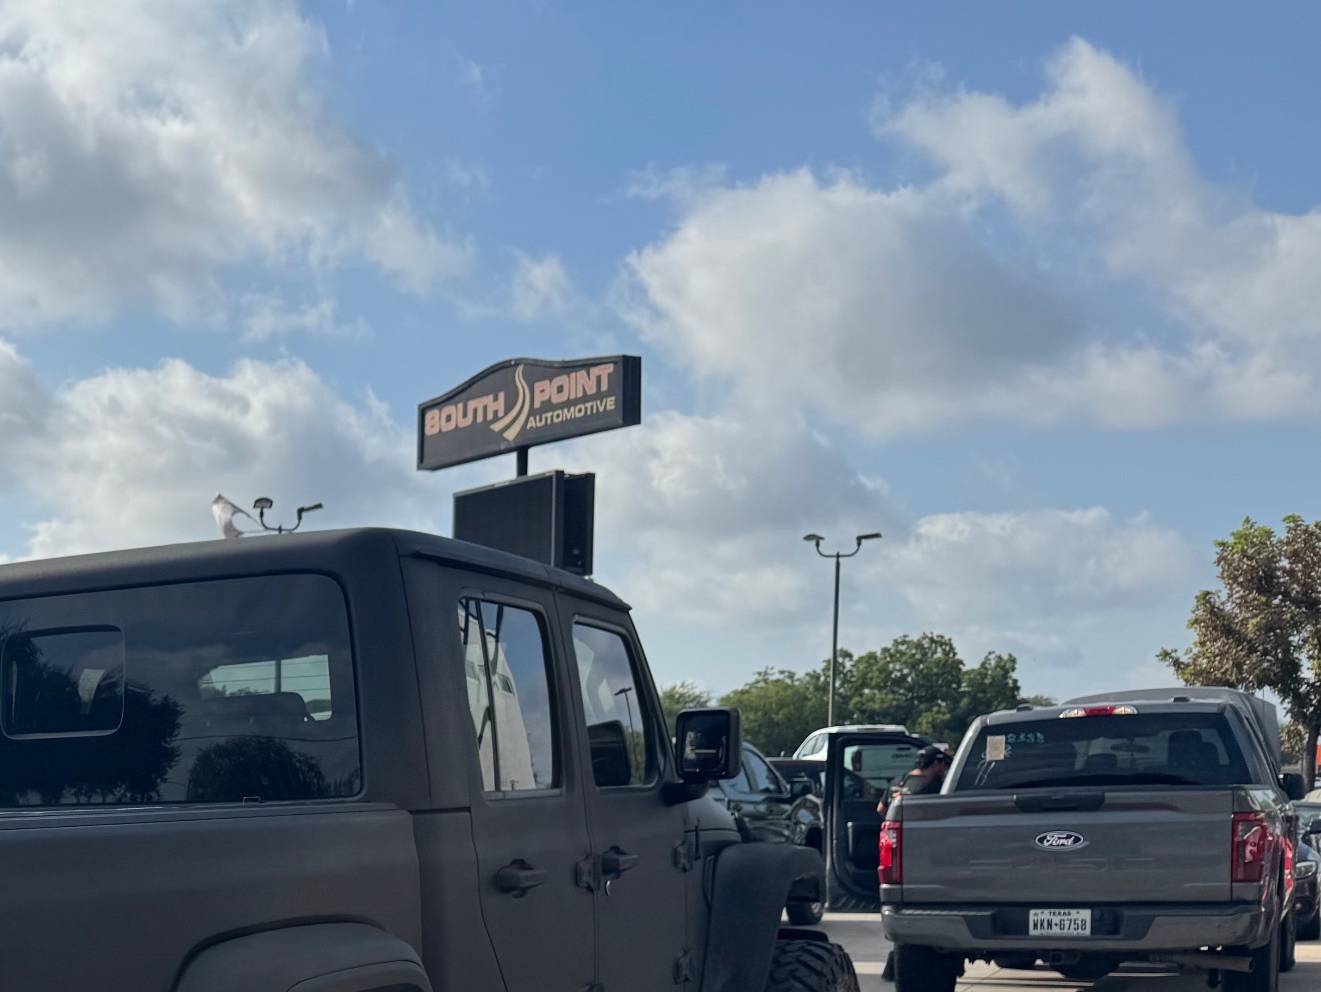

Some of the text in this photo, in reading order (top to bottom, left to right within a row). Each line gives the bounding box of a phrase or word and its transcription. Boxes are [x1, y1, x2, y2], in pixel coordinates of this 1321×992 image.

[425, 363, 615, 436] SOUTH POINT
[526, 396, 616, 430] AUTOMOTIVE
